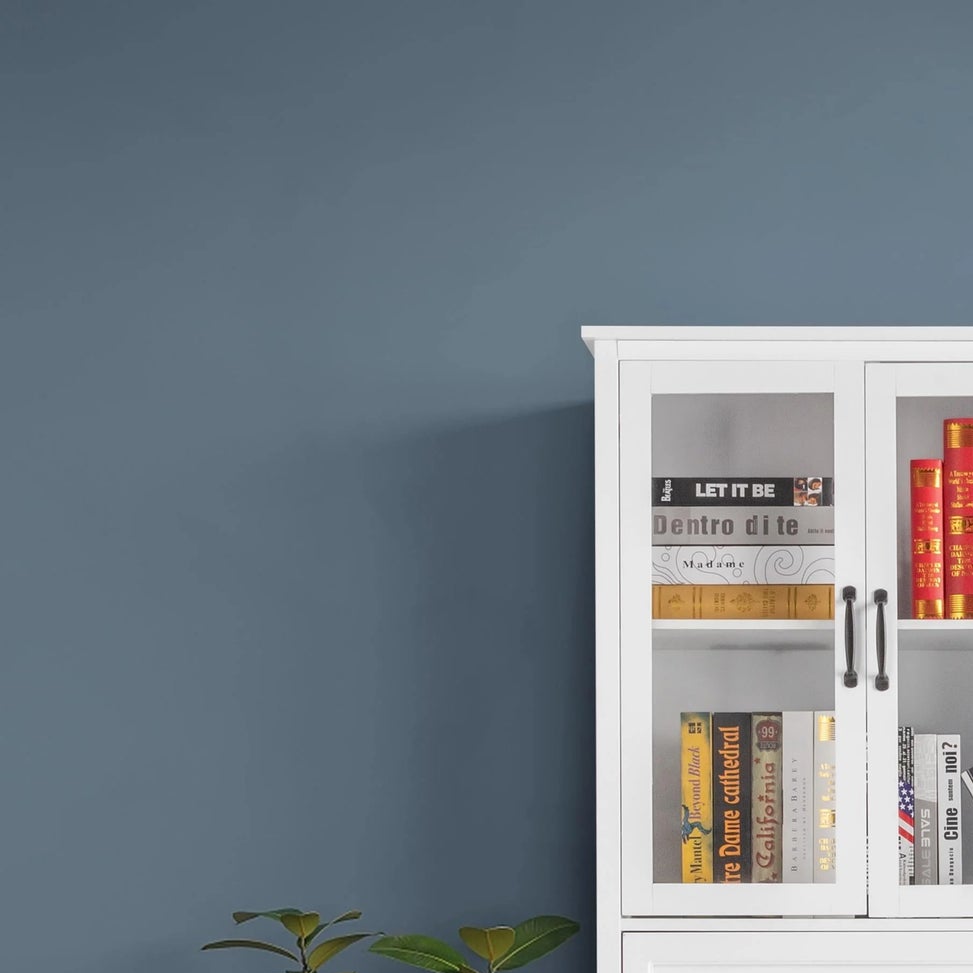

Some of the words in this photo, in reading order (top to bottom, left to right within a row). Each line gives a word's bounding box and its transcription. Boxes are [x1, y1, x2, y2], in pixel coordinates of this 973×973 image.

[696, 483, 728, 497] LET
[732, 484, 748, 497] IT
[752, 484, 775, 497] BE
[654, 515, 734, 535] Dentro
[746, 515, 768, 535] di
[777, 516, 798, 535] te
[683, 560, 744, 568] Madame
[761, 726, 775, 738] 99
[688, 746, 701, 776] Black
[718, 726, 740, 804] cathedral
[942, 742, 957, 773] noi?
[689, 780, 705, 819] Beyond
[756, 762, 780, 868] California
[719, 810, 741, 857] Dame
[921, 809, 930, 847] SALE
[944, 807, 958, 840] Cine
[689, 836, 702, 873] Mantel
